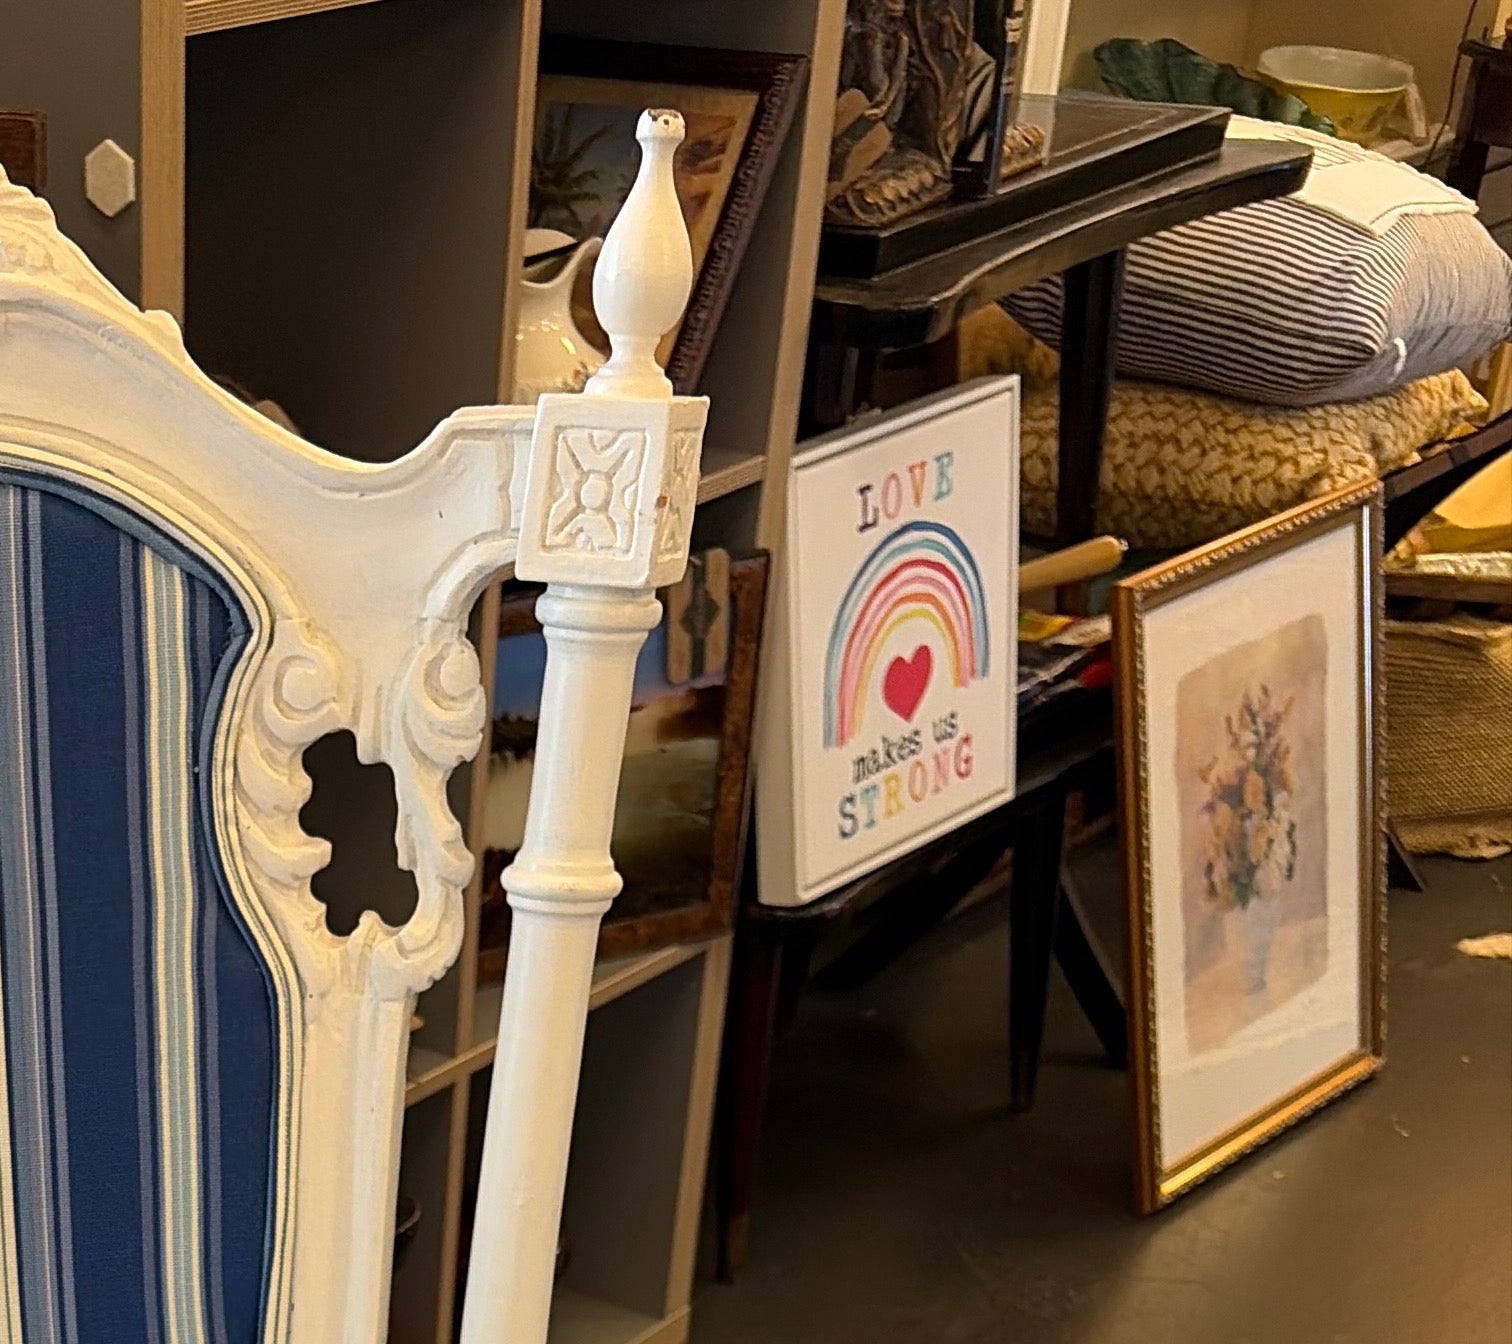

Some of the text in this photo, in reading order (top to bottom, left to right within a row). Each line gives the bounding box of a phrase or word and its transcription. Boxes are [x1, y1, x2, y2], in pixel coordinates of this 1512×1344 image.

[857, 452, 953, 533] LOVE
[839, 733, 974, 840] STRONG
[852, 711, 958, 784] makes us
